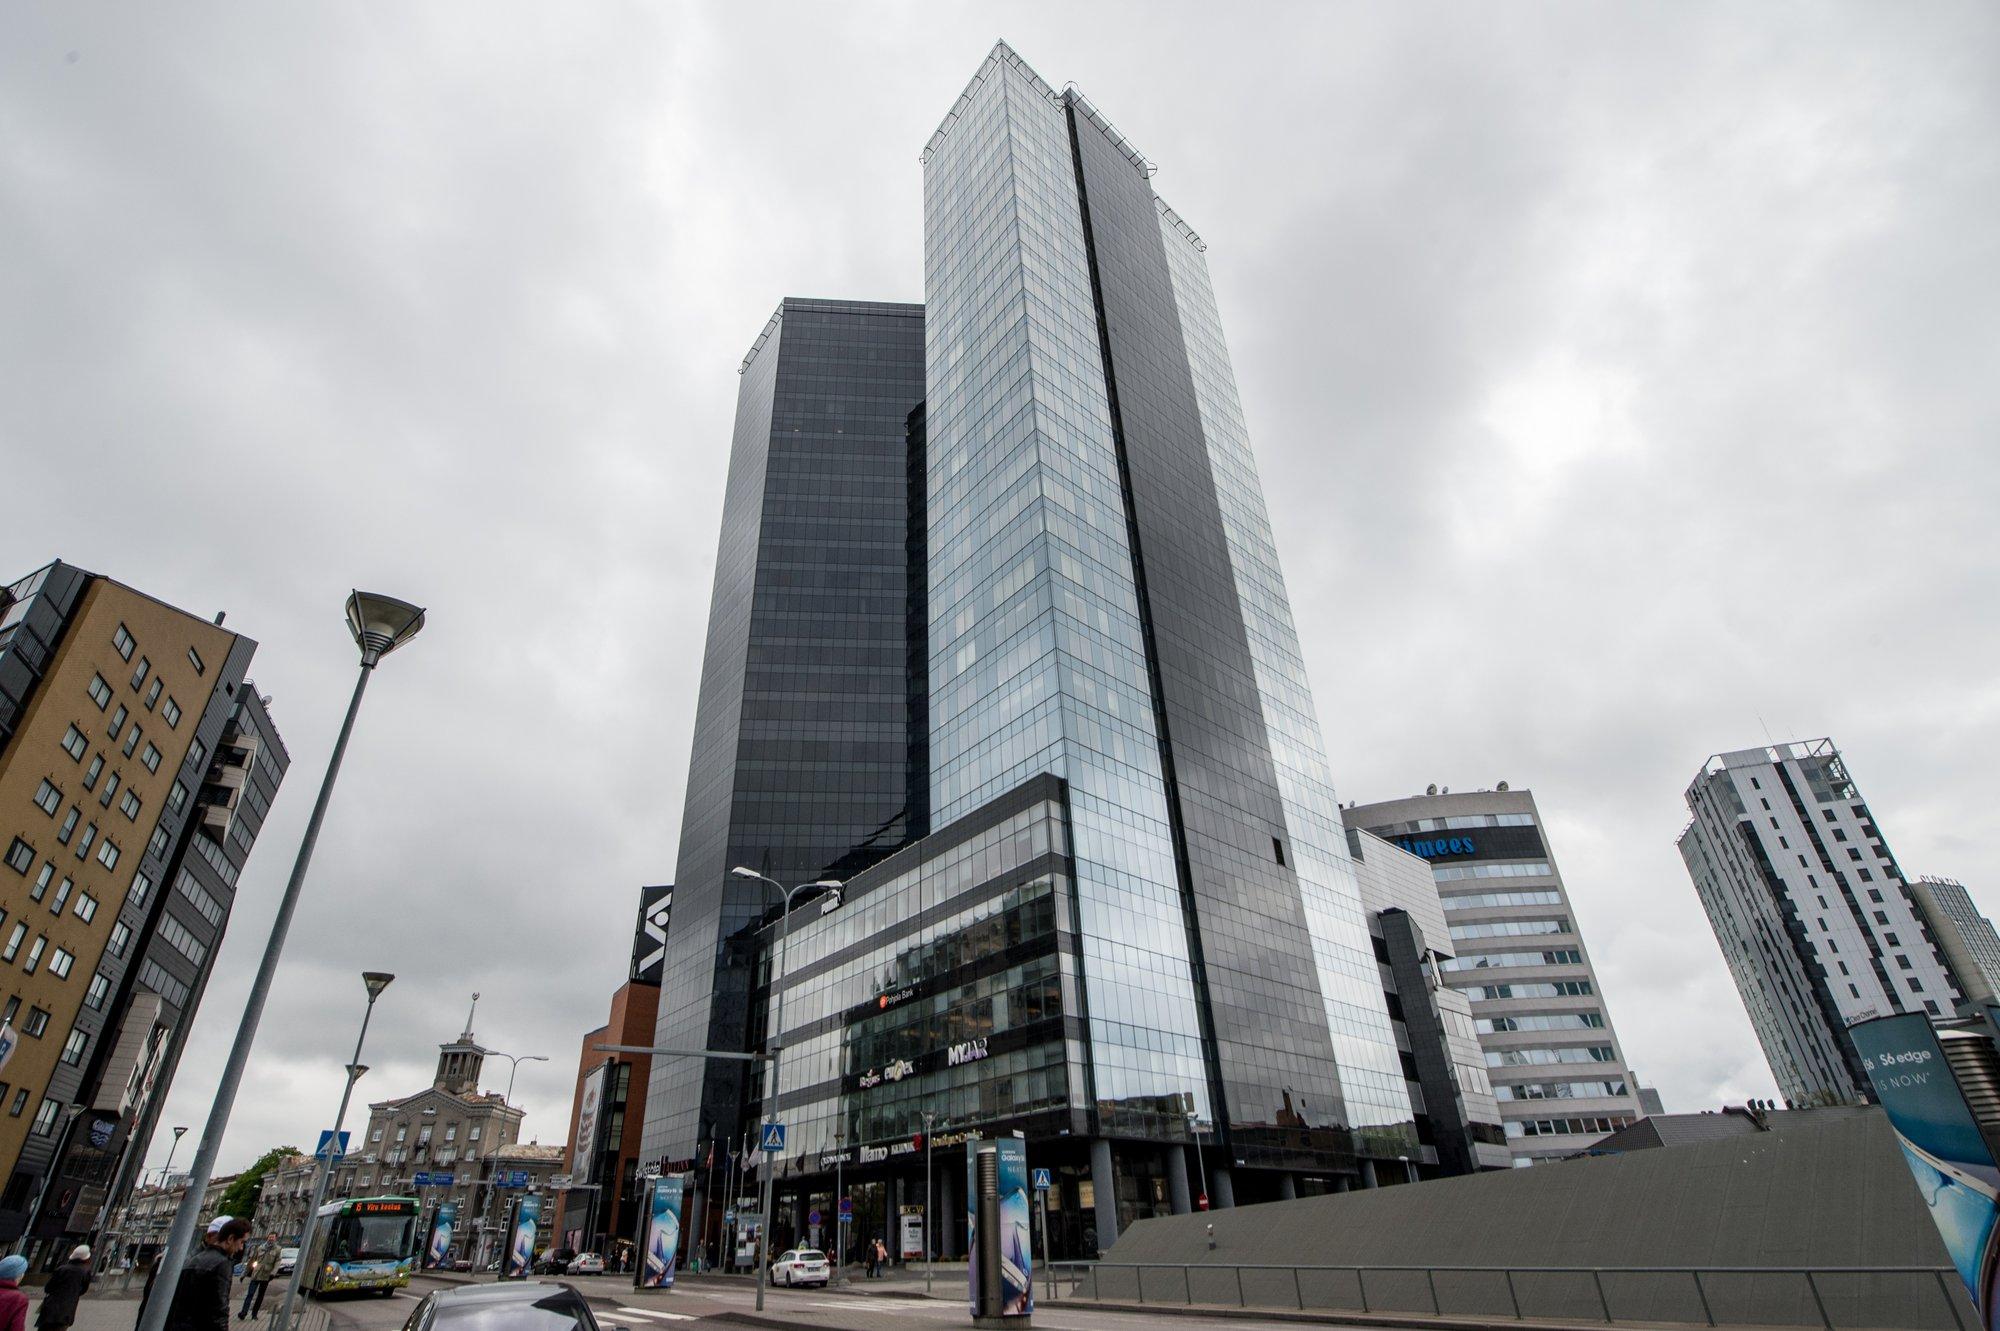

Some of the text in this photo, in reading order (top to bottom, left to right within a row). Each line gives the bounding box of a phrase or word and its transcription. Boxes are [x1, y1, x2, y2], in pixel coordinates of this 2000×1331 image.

[1397, 837, 1475, 858] imees
[902, 989, 913, 999] Bank
[948, 1037, 988, 1067] MYJAR
[1879, 1052, 1896, 1066] S6
[1896, 1050, 1932, 1064] edge
